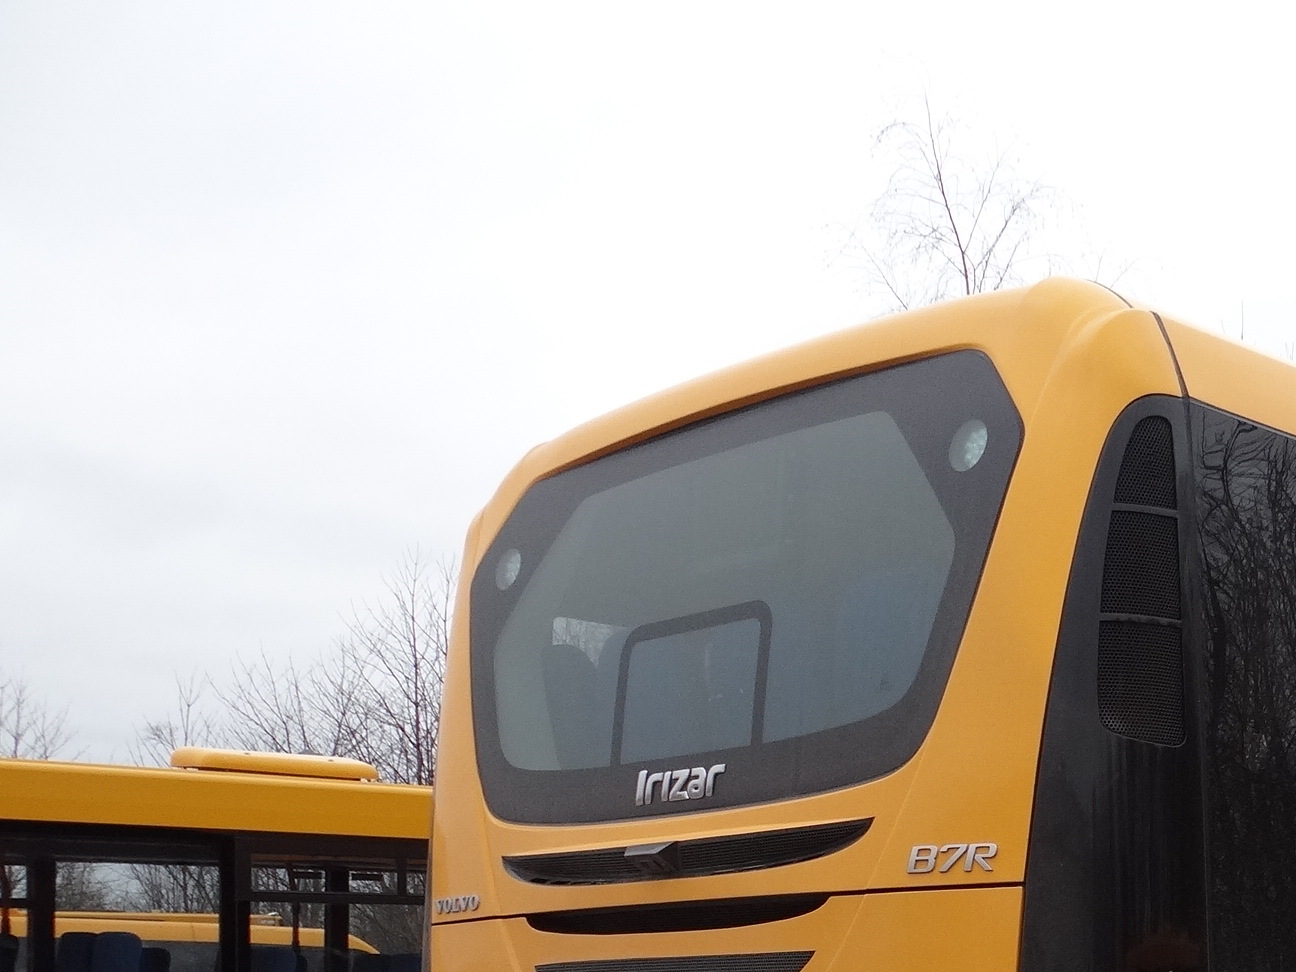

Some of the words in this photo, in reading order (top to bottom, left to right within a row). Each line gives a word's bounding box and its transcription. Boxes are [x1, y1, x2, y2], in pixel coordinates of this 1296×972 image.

[635, 763, 726, 806] Irizar
[907, 842, 998, 874] B7R
[436, 896, 481, 915] VOLVO
